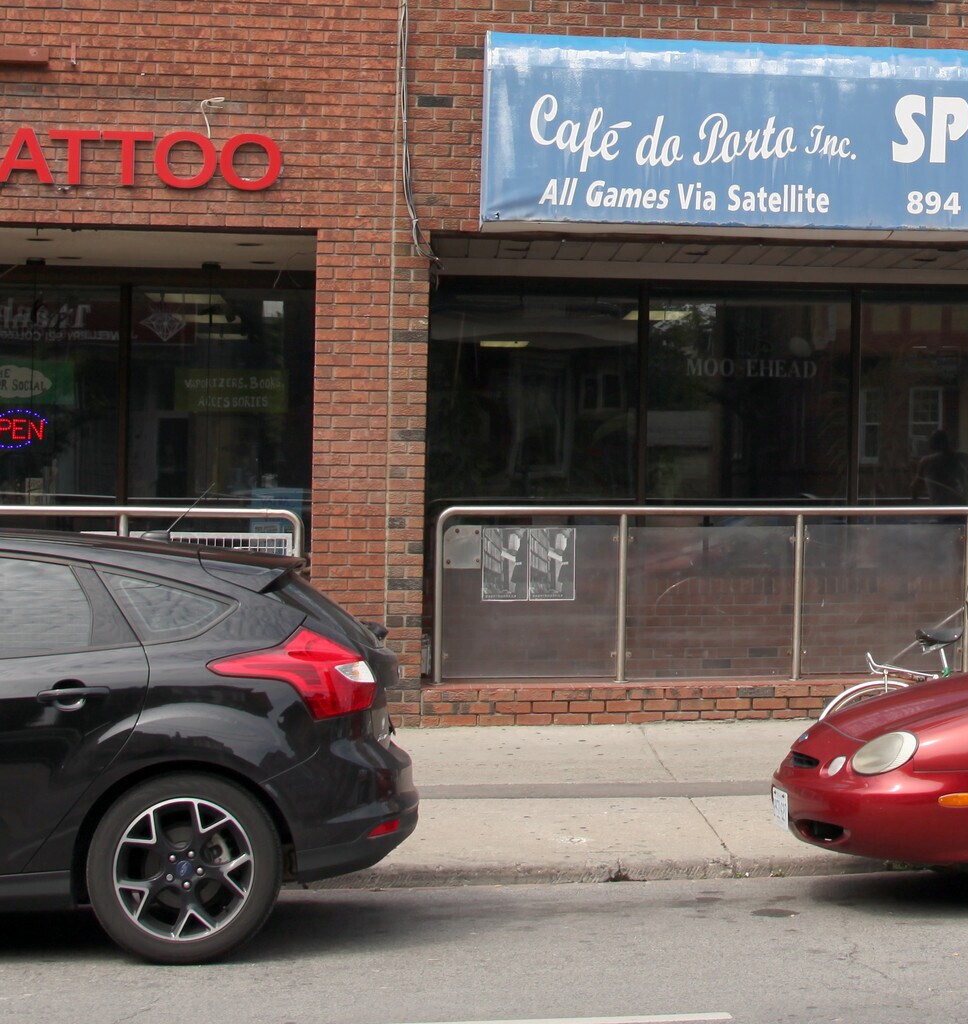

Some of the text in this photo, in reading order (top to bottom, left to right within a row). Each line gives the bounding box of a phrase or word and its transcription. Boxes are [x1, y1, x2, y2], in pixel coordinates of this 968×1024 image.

[0, 127, 281, 190] ATTOO
[530, 94, 858, 173] Café do Porto Inc.
[538, 177, 830, 214] All Games Via Satellite
[906, 190, 962, 216] 894
